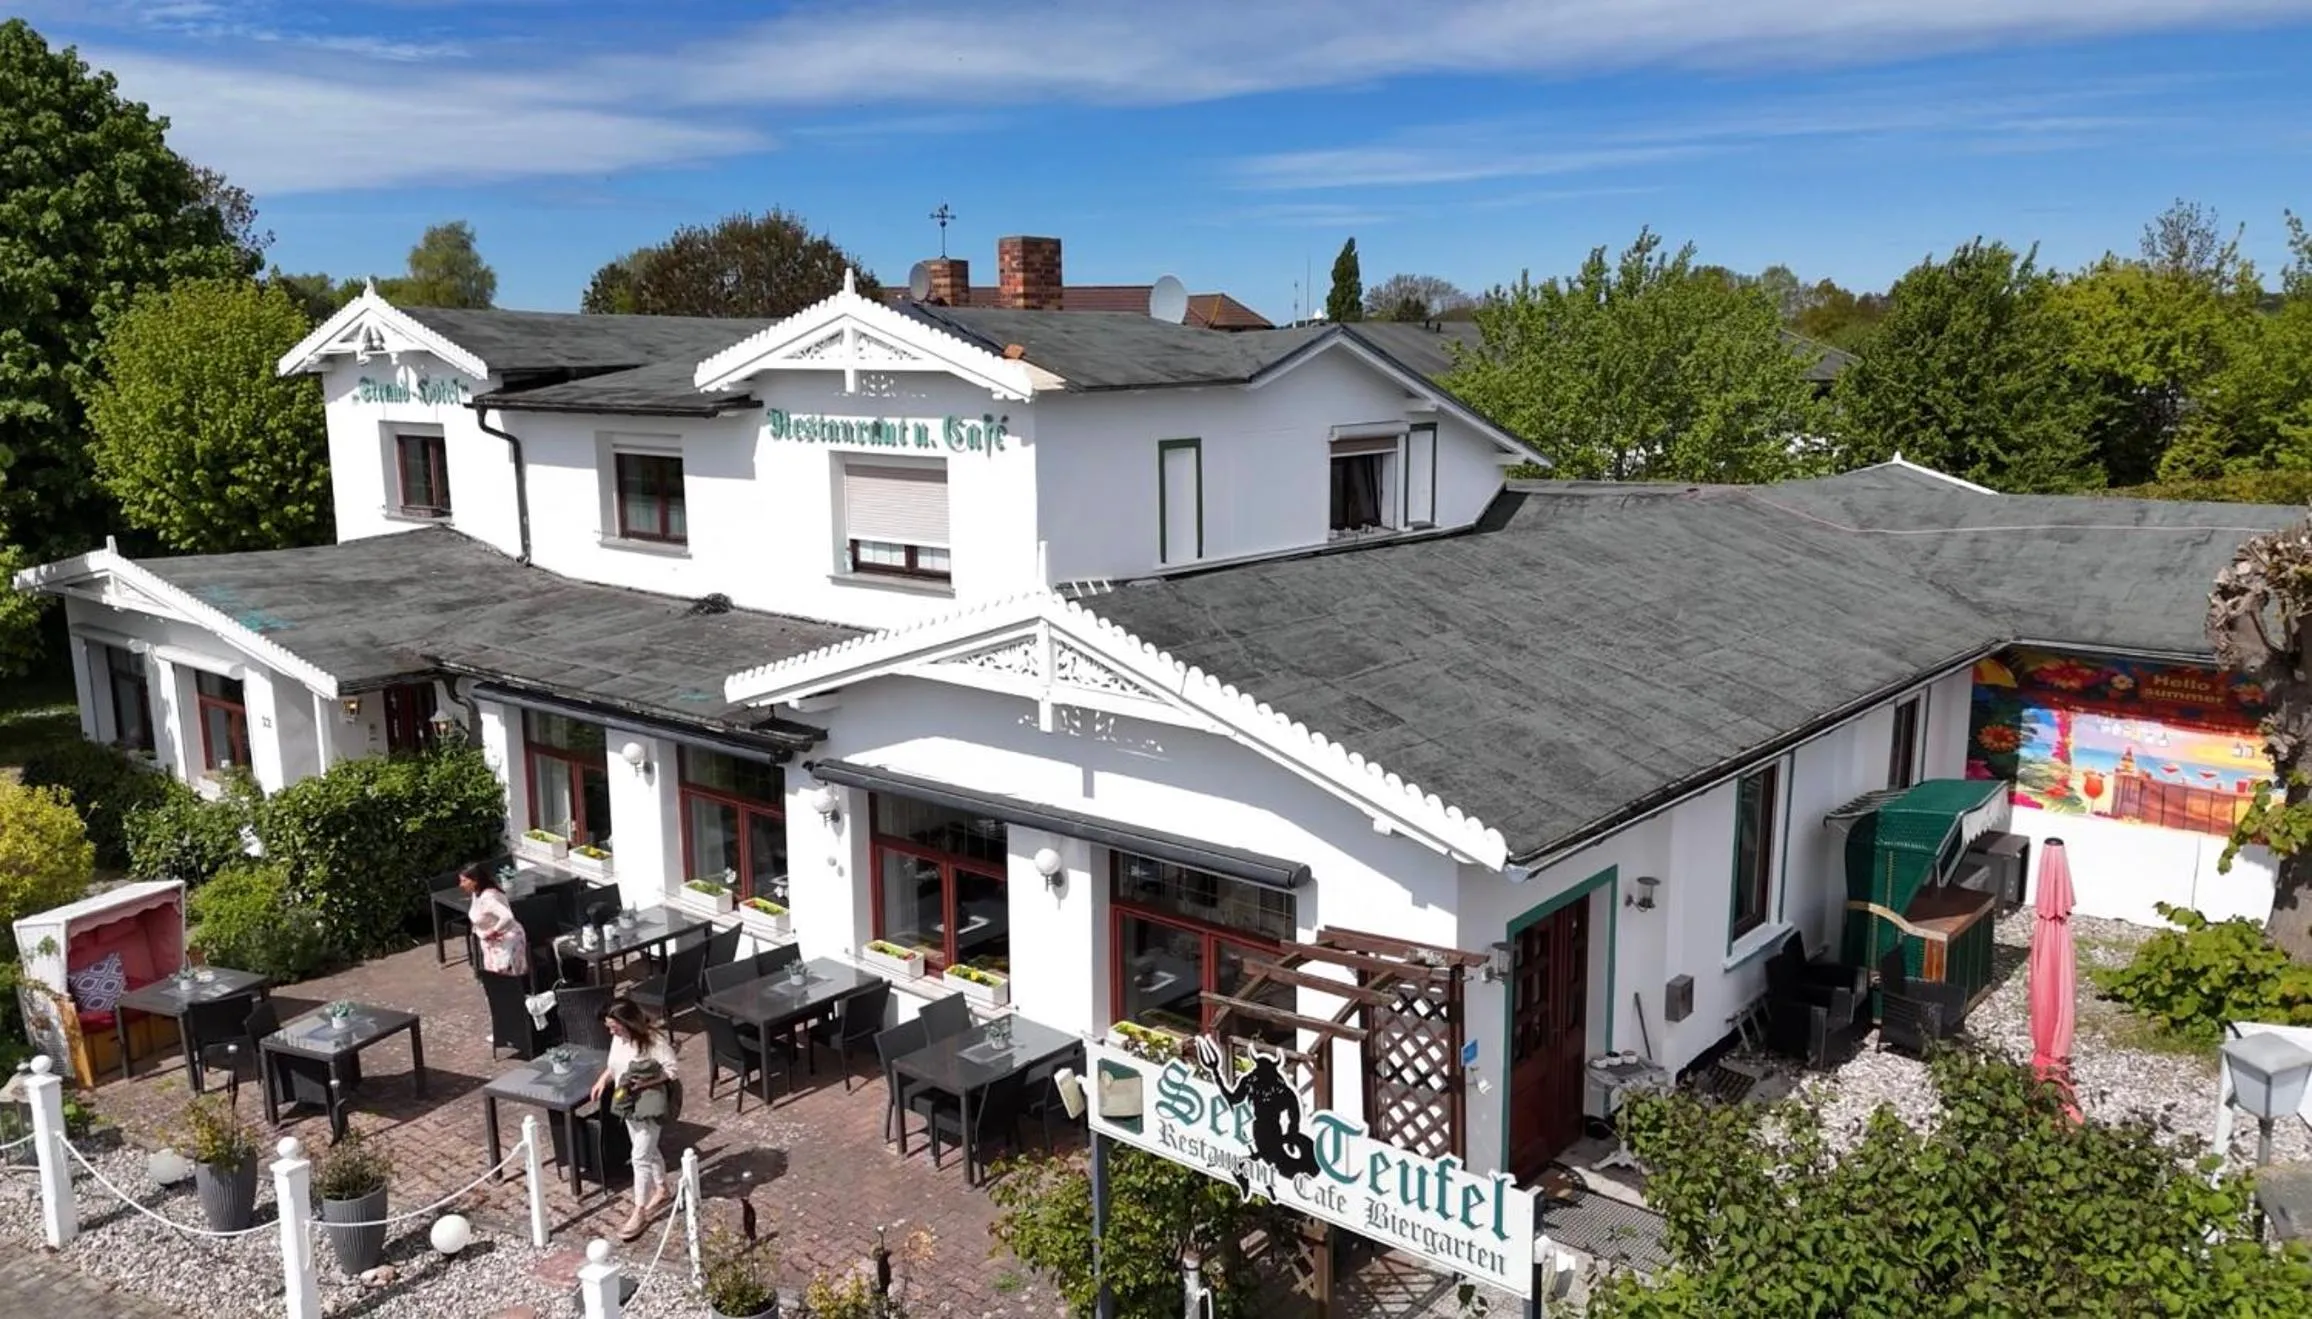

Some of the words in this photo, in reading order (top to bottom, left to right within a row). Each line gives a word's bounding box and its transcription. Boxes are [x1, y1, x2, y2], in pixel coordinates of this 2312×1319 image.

[913, 420, 939, 450] u.
[2153, 674, 2211, 690] Hello
[1155, 1061, 1254, 1146] See
[1313, 1113, 1511, 1242] Teufel
[1364, 1196, 1506, 1276] Biergarten
